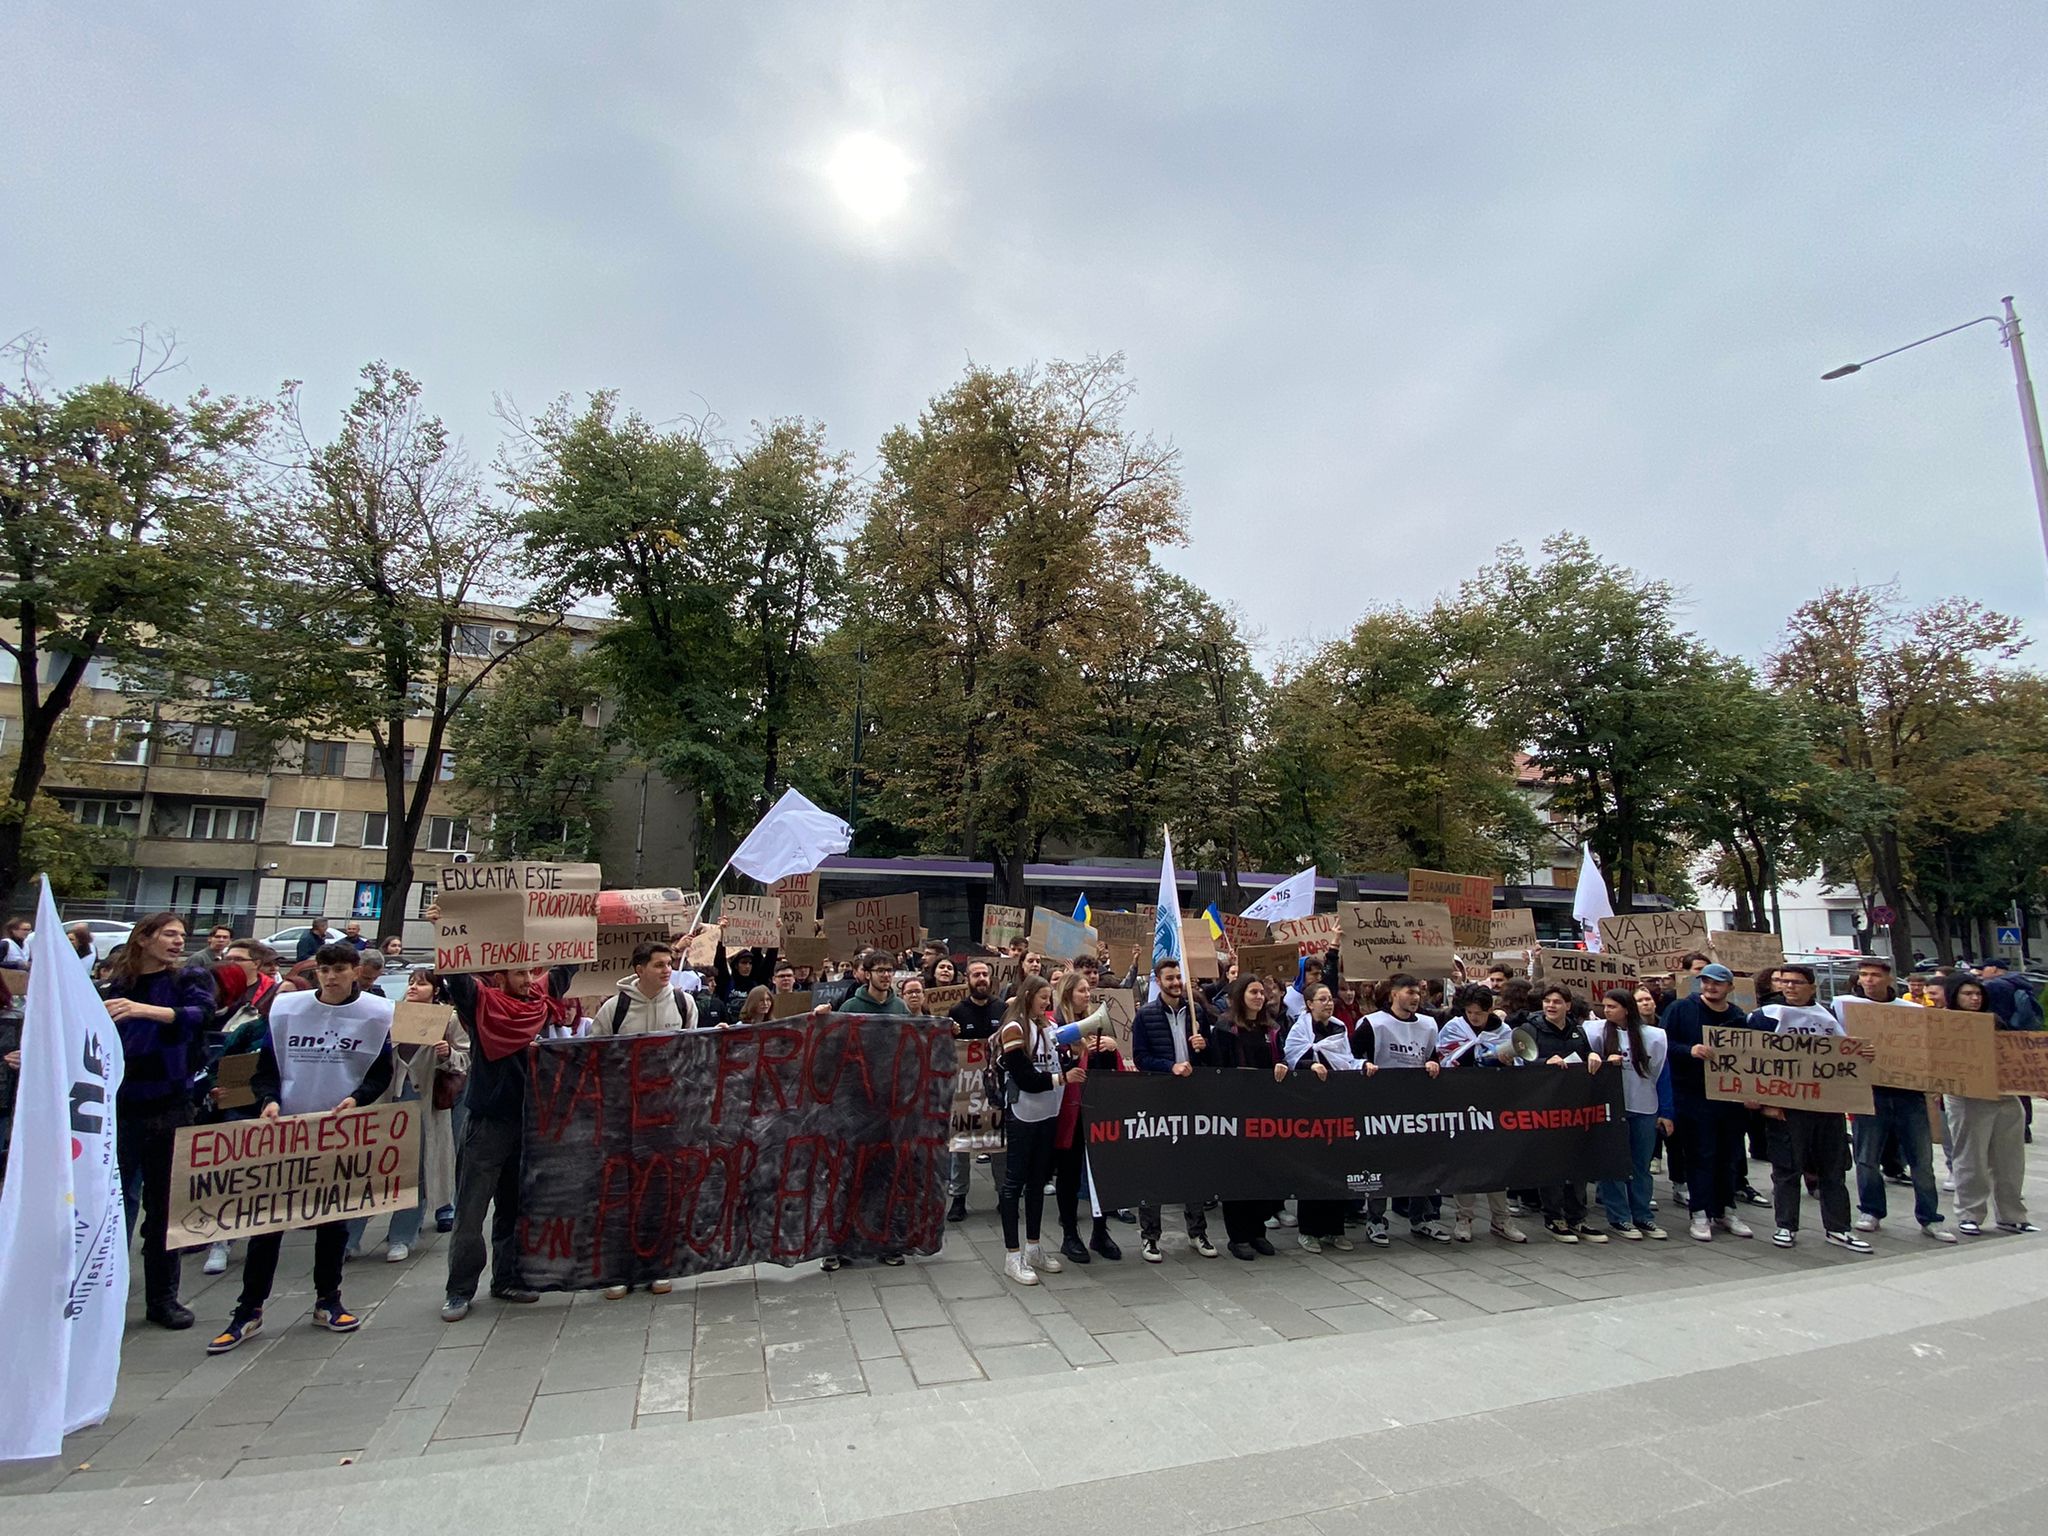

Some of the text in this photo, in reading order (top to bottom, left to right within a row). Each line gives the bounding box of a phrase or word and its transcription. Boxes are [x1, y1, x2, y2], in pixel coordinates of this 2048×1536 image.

[526, 867, 562, 889] ESTE
[441, 924, 468, 936] DAR
[847, 915, 908, 935] BURSELE
[1224, 915, 1248, 928] 2025
[481, 939, 540, 966] PENSIILE
[547, 938, 594, 961] SPECIALE
[1622, 963, 1637, 977] DE
[1762, 1032, 1832, 1056] PROMIS
[630, 1037, 677, 1129] E
[889, 1023, 956, 1121] DE
[1719, 1076, 1742, 1094] LA
[317, 1111, 380, 1151] ESTE
[390, 1110, 408, 1140] O
[1090, 1103, 1611, 1145] NU TĂIAȚI DIN EDUCAȚIE, INVESTIȚI ÎN GENERAȚIE!
[334, 1150, 372, 1181] NU
[378, 1146, 399, 1175] O
[520, 1216, 575, 1260] UN
[592, 1139, 760, 1279] POPOR
